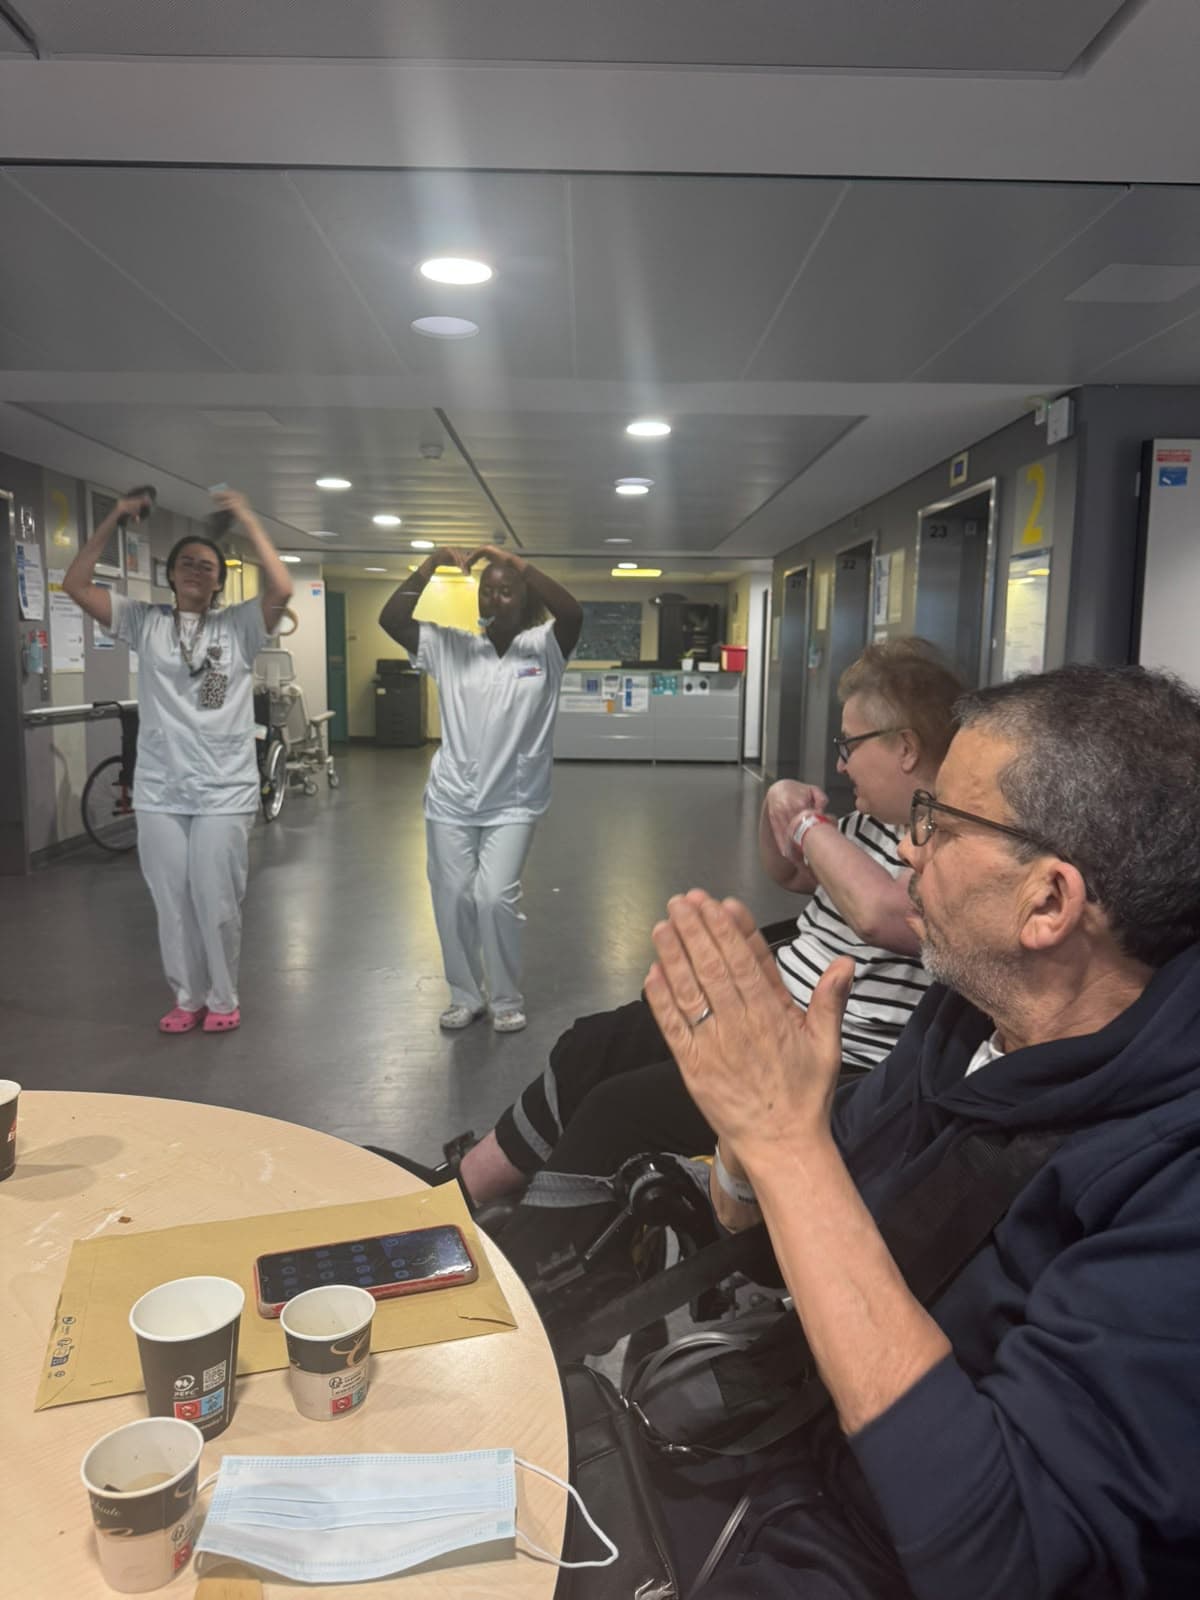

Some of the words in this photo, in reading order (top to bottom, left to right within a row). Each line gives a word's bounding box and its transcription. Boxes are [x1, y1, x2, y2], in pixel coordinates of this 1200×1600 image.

[52, 491, 71, 546] 2
[929, 525, 948, 538] 23
[1021, 463, 1046, 545] 2
